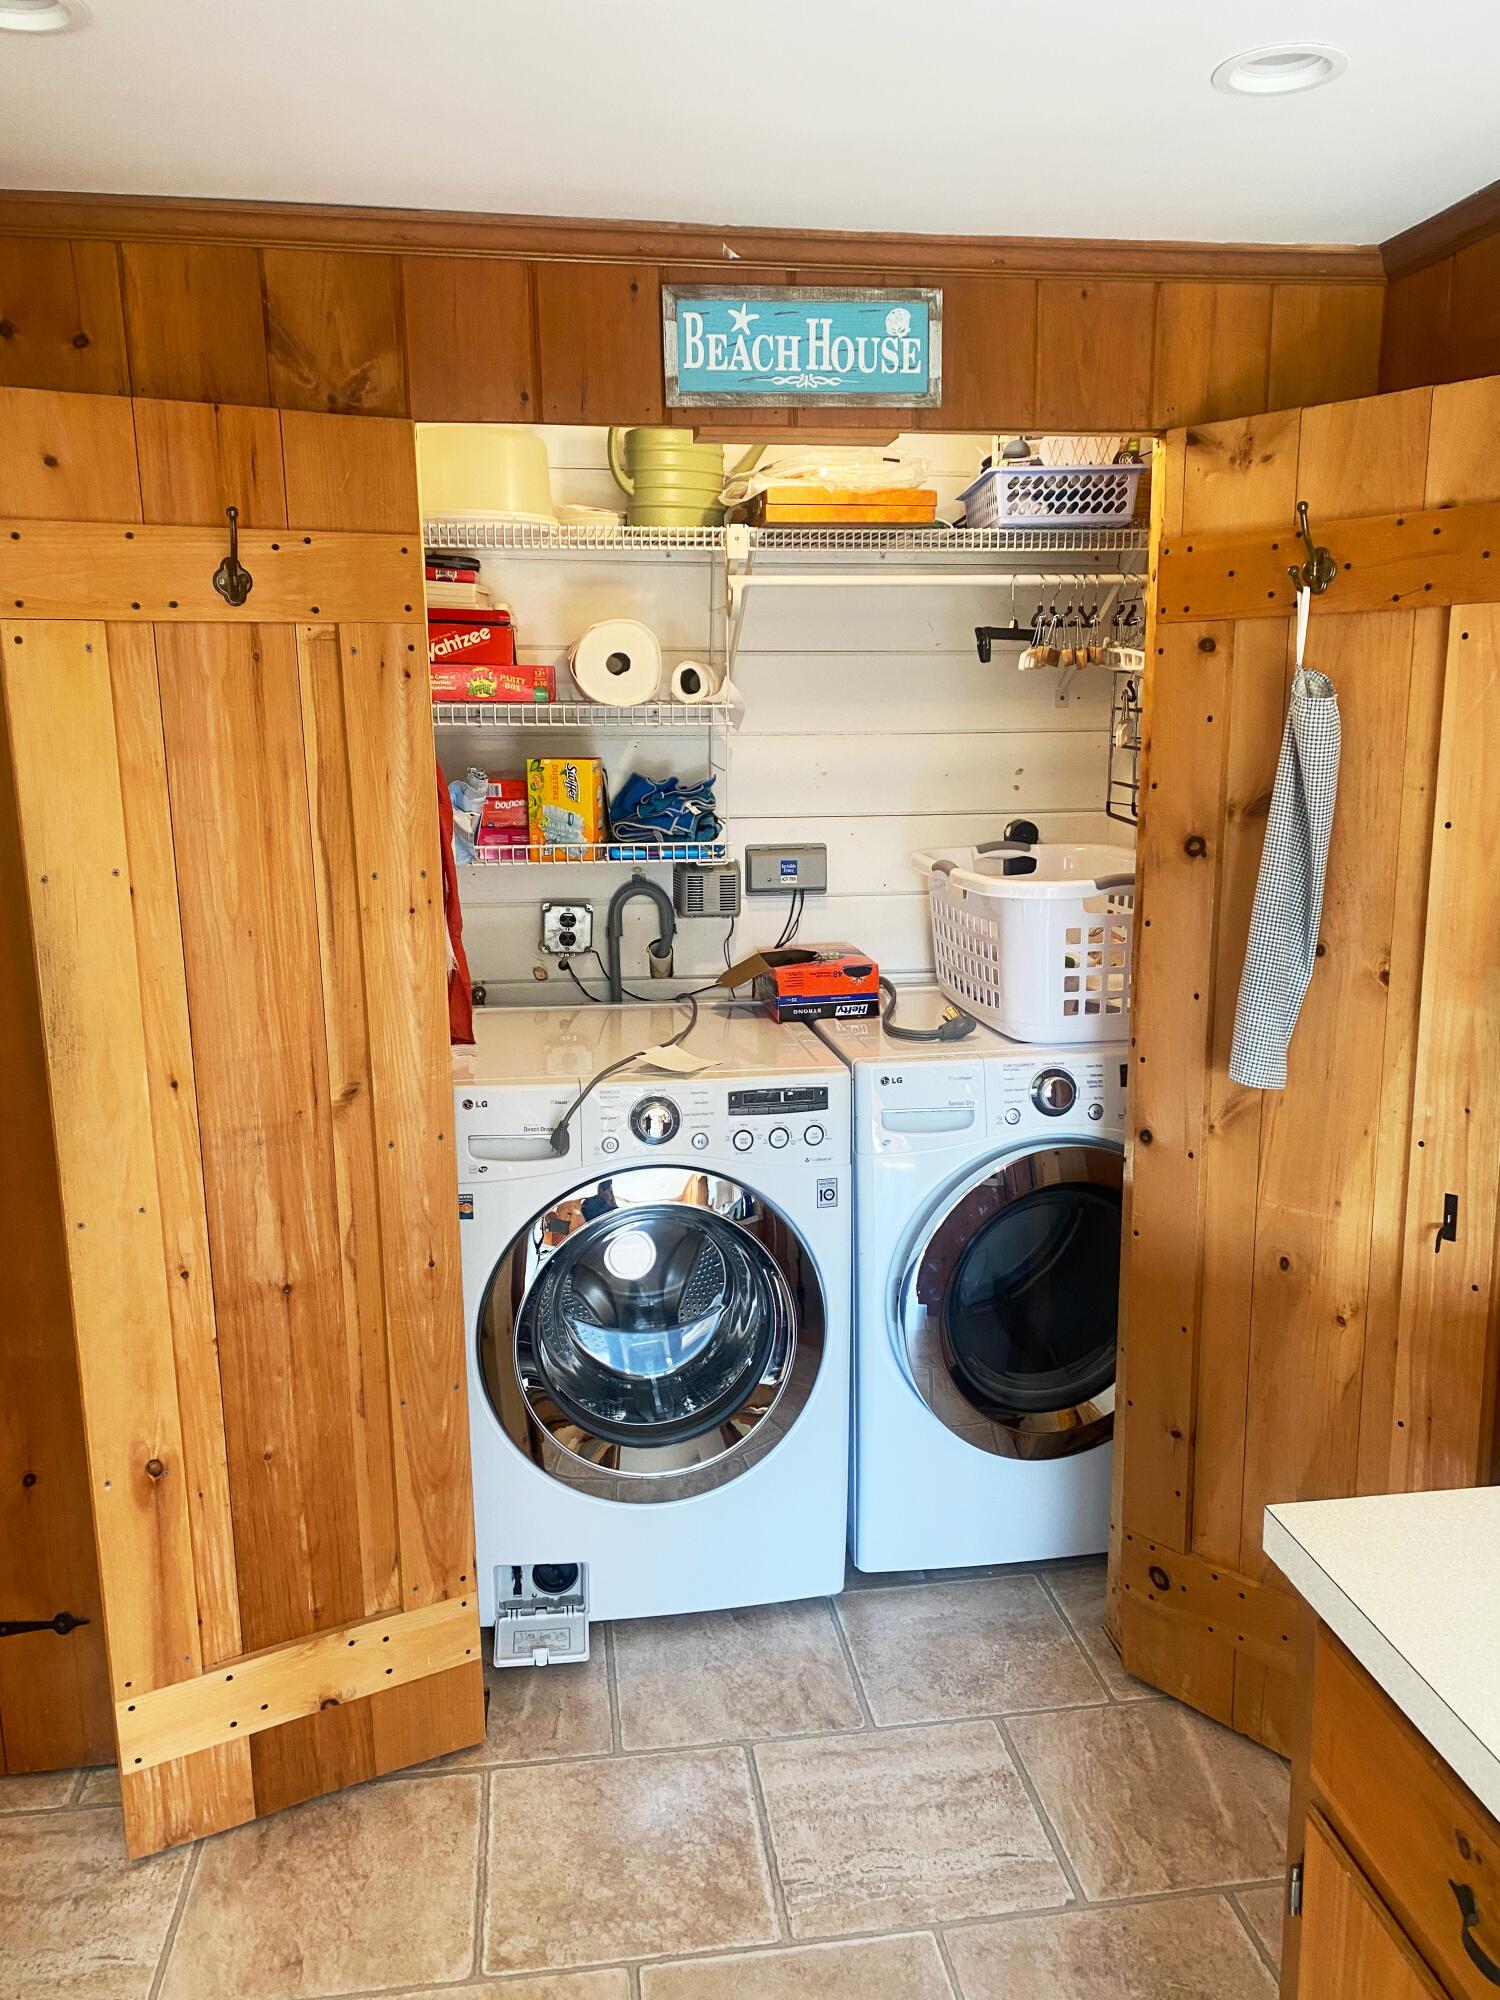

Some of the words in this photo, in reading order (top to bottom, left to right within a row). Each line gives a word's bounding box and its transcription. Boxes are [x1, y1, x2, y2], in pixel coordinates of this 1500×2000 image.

[683, 312, 801, 371] BEACH
[806, 318, 921, 374] HOUSE
[500, 674, 526, 686] PARTY
[504, 683, 521, 692] BOX
[564, 762, 578, 802] Swiffer
[495, 799, 525, 809] bounce
[837, 1005, 868, 1015] Hefty
